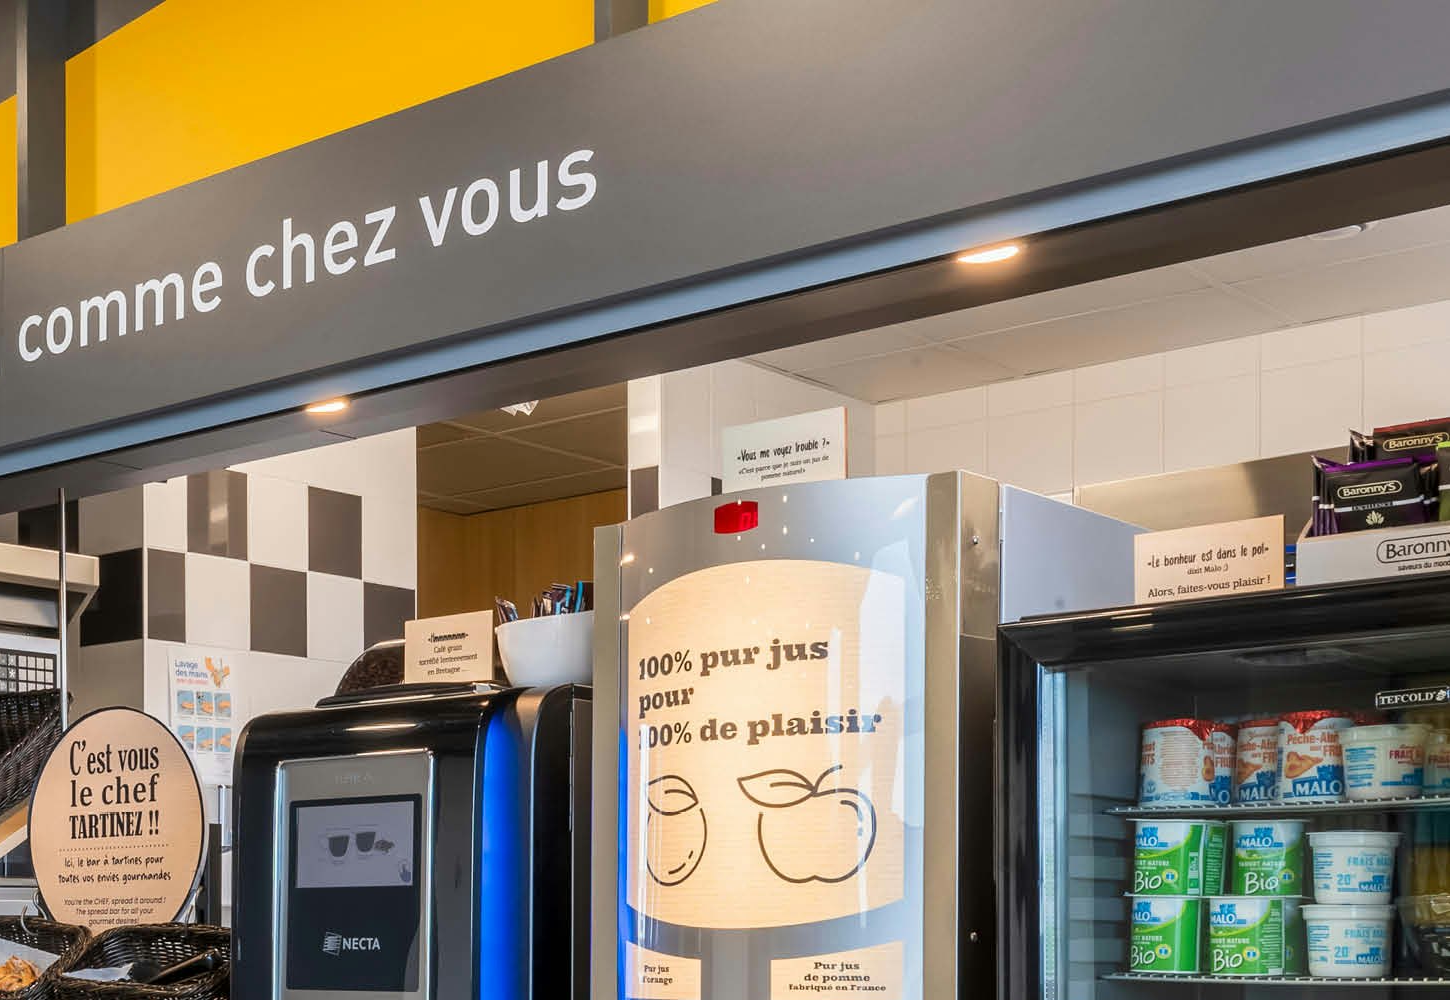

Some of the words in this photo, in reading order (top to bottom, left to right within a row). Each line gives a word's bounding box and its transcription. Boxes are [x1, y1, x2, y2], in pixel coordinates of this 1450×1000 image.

[18, 258, 223, 360] comme
[245, 208, 396, 298] chez
[420, 149, 598, 245] vous
[760, 449, 770, 458] me
[773, 445, 792, 458] voyez
[795, 440, 818, 452] trouble
[1164, 553, 1196, 567] bonheur
[1201, 549, 1213, 561] est
[1217, 547, 1236, 560] dans
[1241, 545, 1247, 557] le
[1204, 565, 1221, 573] Malo
[1398, 563, 1422, 571] saveurs
[1148, 588, 1175, 598] Alors,
[1178, 581, 1230, 595] faites-vous
[1233, 576, 1265, 590] plaisir
[175, 659, 198, 669] Lavage
[639, 650, 692, 680] 100%
[700, 646, 759, 676] pur
[766, 638, 828, 670] jus
[189, 670, 208, 678] mains
[639, 687, 694, 718] pour
[700, 719, 737, 742] de
[747, 709, 882, 745] plaisir
[70, 740, 112, 776] C'est
[118, 746, 159, 772] vous
[70, 779, 92, 807] le
[102, 773, 160, 805] chef
[1295, 780, 1342, 796] MALO
[69, 811, 142, 839] TARTINEZ
[149, 810, 159, 835] !!
[1241, 837, 1273, 847] MALO
[65, 858, 75, 869] Ici,
[78, 858, 84, 868] le
[87, 858, 100, 867] bar
[104, 854, 109, 865] à
[112, 855, 142, 865] tartines
[146, 855, 164, 869] pour
[58, 873, 80, 884] toutes
[82, 875, 94, 883] vos
[98, 872, 120, 883] envies
[123, 869, 171, 885] gourmandes
[1134, 871, 1162, 893] Bio
[1245, 872, 1279, 894] Bio
[112, 897, 133, 906] spread
[140, 897, 162, 905] around
[87, 908, 108, 917] spread
[110, 907, 120, 915] bar
[130, 906, 138, 914] all
[140, 907, 153, 917] your
[89, 918, 114, 927] gourmet
[342, 937, 381, 950] NECTA
[1131, 945, 1156, 967] Bio
[1213, 949, 1243, 972] Bio
[644, 965, 656, 973] Pur
[657, 965, 670, 974] jus
[814, 962, 837, 970] Pur
[839, 962, 860, 972] jus
[804, 973, 819, 982] de
[822, 975, 871, 984] pomme
[789, 983, 833, 992] fabriqué
[850, 984, 887, 992] France
